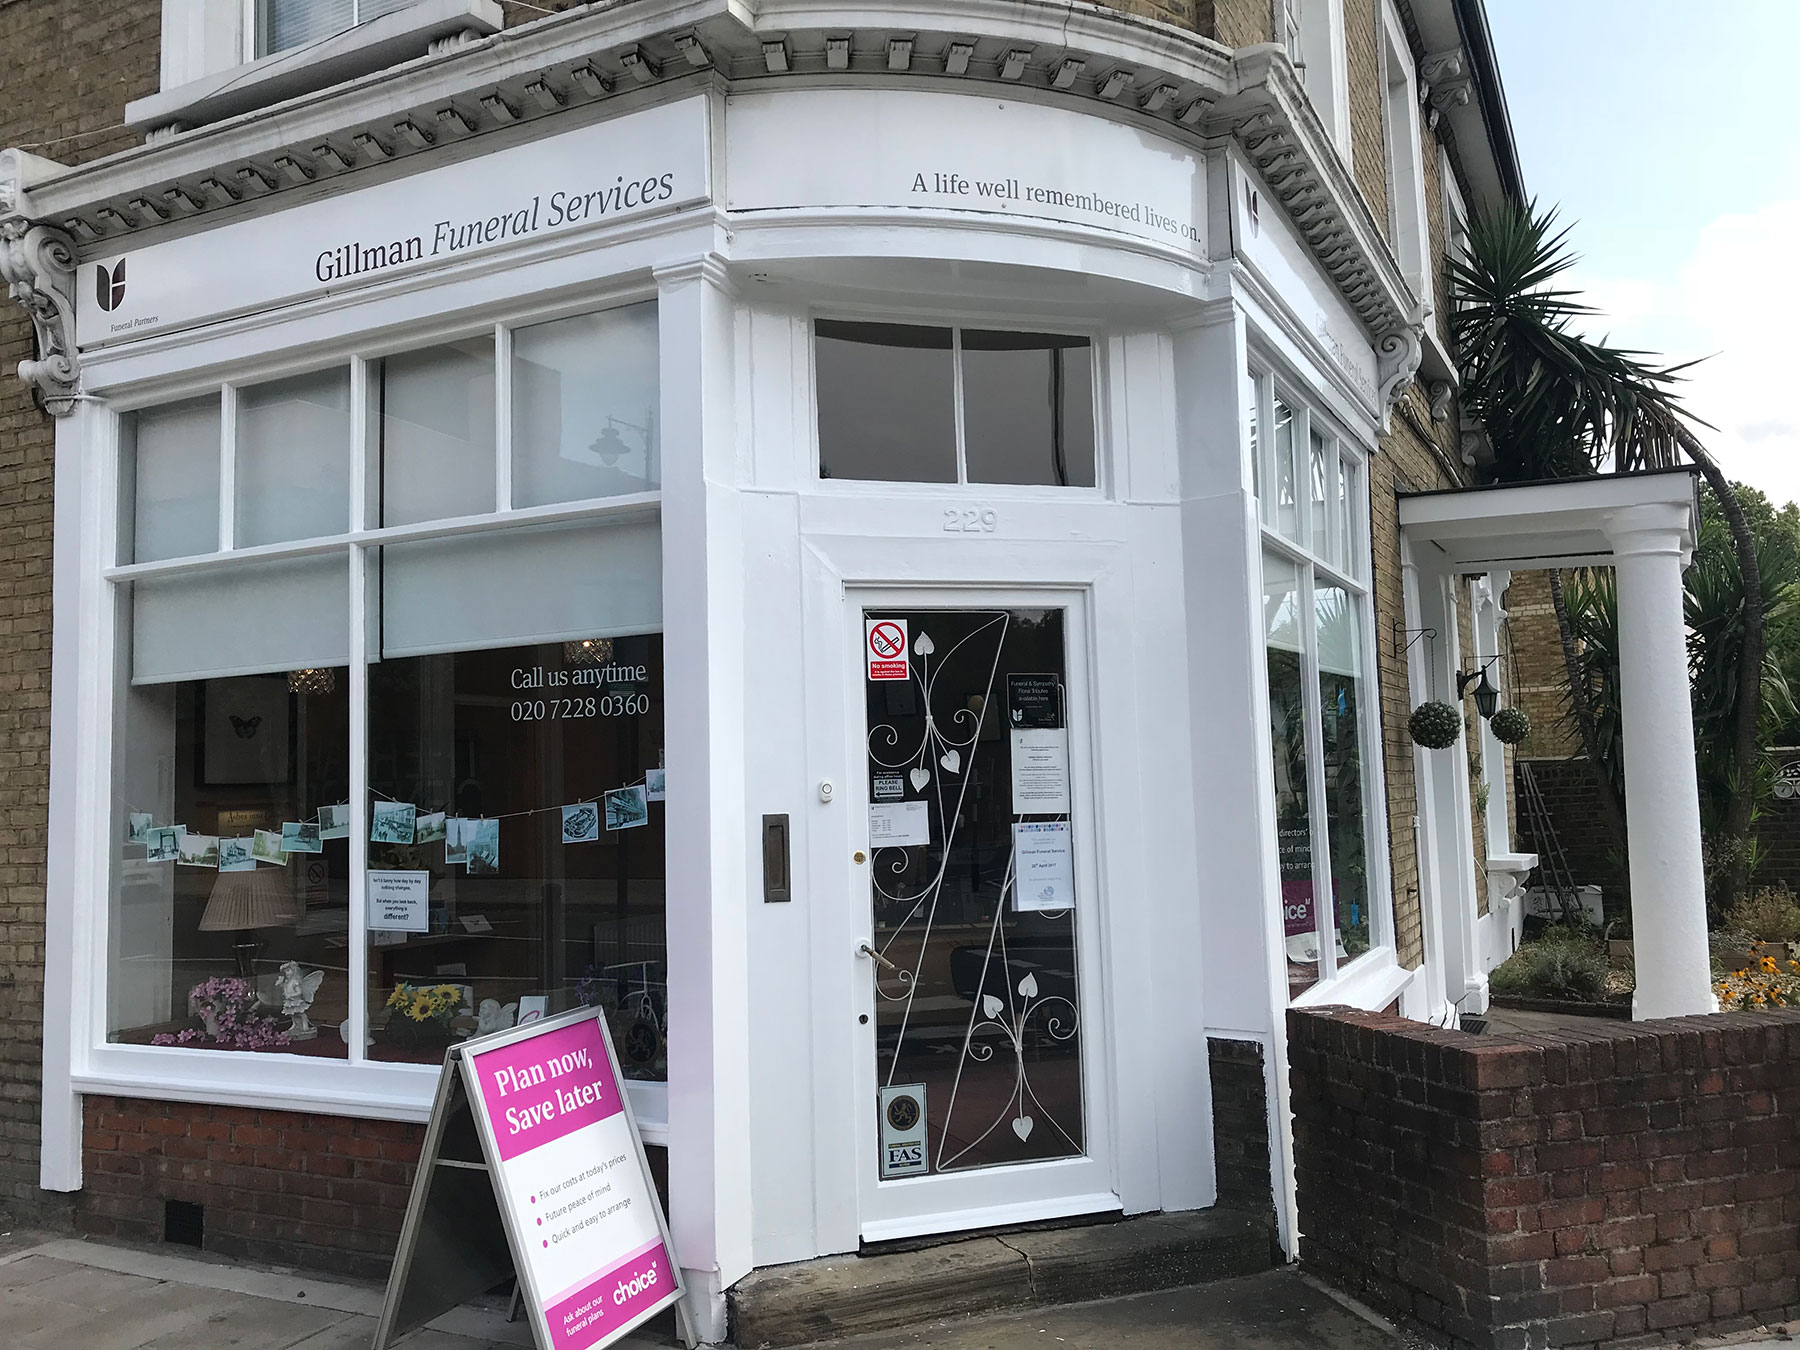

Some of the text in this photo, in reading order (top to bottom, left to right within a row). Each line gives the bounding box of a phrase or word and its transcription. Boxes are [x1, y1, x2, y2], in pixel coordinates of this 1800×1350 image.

[911, 172, 1201, 243] A life well remembered lives on.
[315, 172, 673, 282] Gillman Funeral Services
[111, 315, 159, 333] Funeral Partners
[943, 506, 998, 534] 229
[511, 661, 647, 689] Call us anytime
[510, 693, 650, 722] 020 7228 0360
[383, 912, 410, 920] different?
[1284, 899, 1307, 920] ice
[493, 1047, 593, 1097] Plan now,
[505, 1080, 603, 1135] Save later
[889, 1146, 922, 1163] FAS
[539, 1189, 550, 1200] Fix
[550, 1184, 561, 1196] our
[562, 1177, 579, 1190] costs
[579, 1172, 586, 1182] at
[608, 1153, 627, 1170] prices
[545, 1182, 612, 1222] Future peace of mind
[551, 1197, 632, 1244] Quick and easy to arrange
[613, 1269, 658, 1306] choice
[563, 1295, 603, 1325] Ask about our
[566, 1309, 605, 1337] funeral plans
